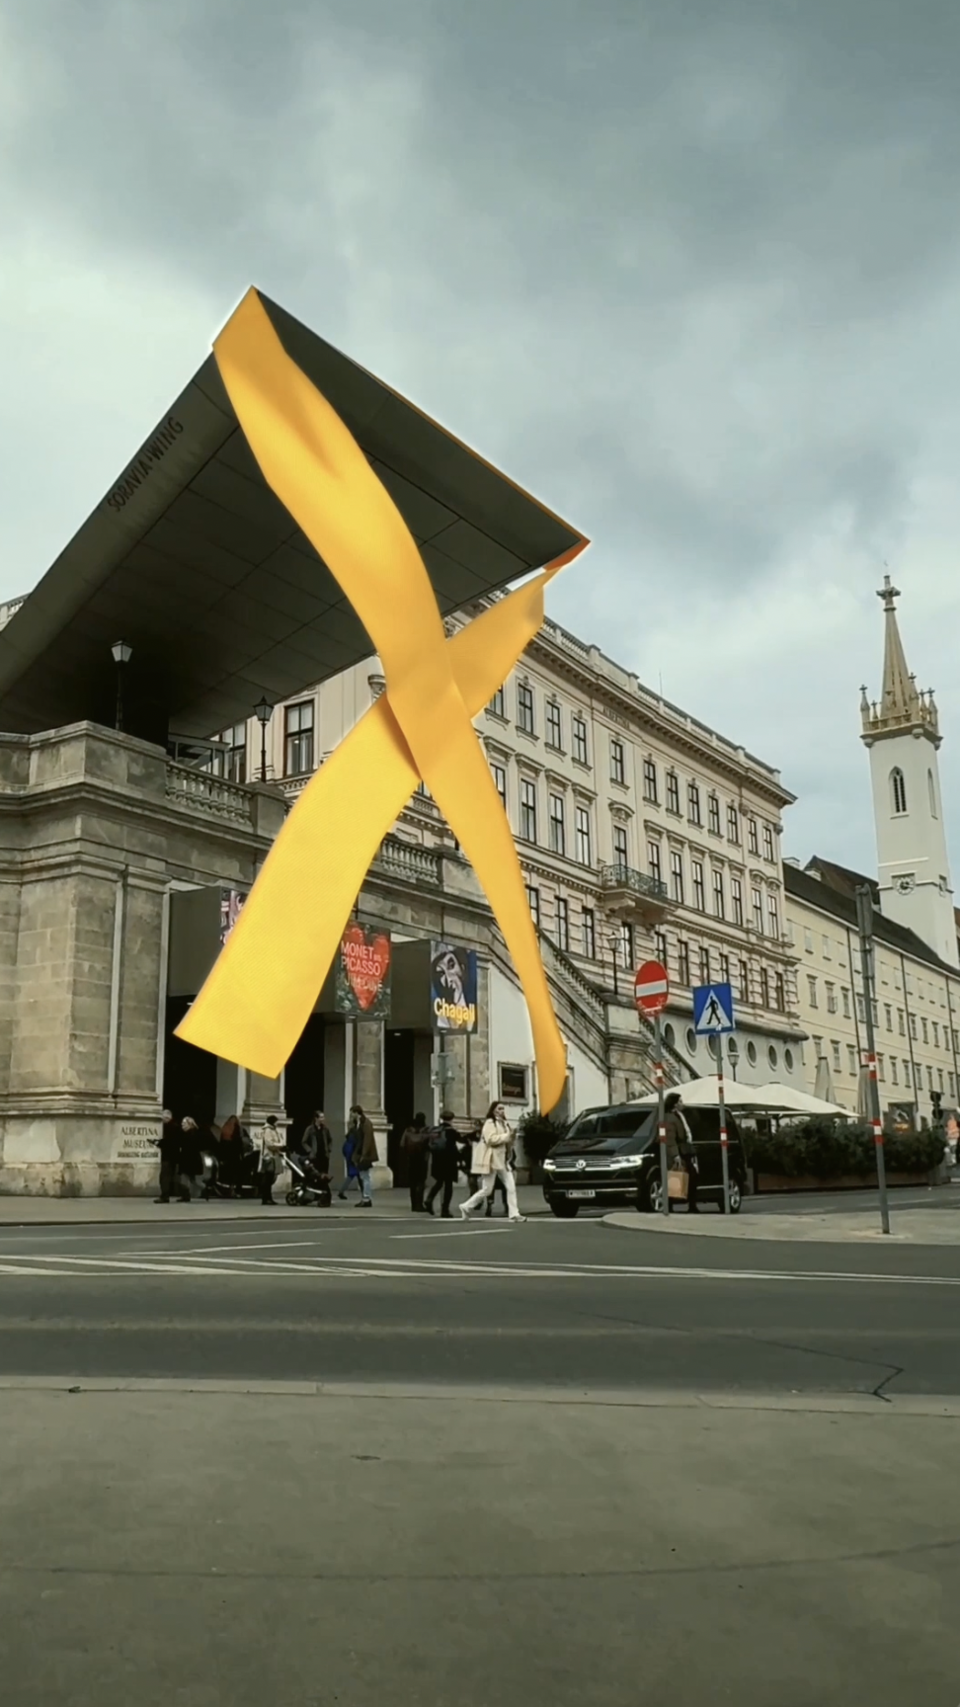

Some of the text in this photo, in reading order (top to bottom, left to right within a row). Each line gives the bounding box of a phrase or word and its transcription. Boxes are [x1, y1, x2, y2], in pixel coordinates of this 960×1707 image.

[341, 940, 374, 960] MONET
[341, 956, 381, 976] PICASSO
[434, 997, 476, 1024] Chagall
[121, 1126, 159, 1136] ALBERTINA
